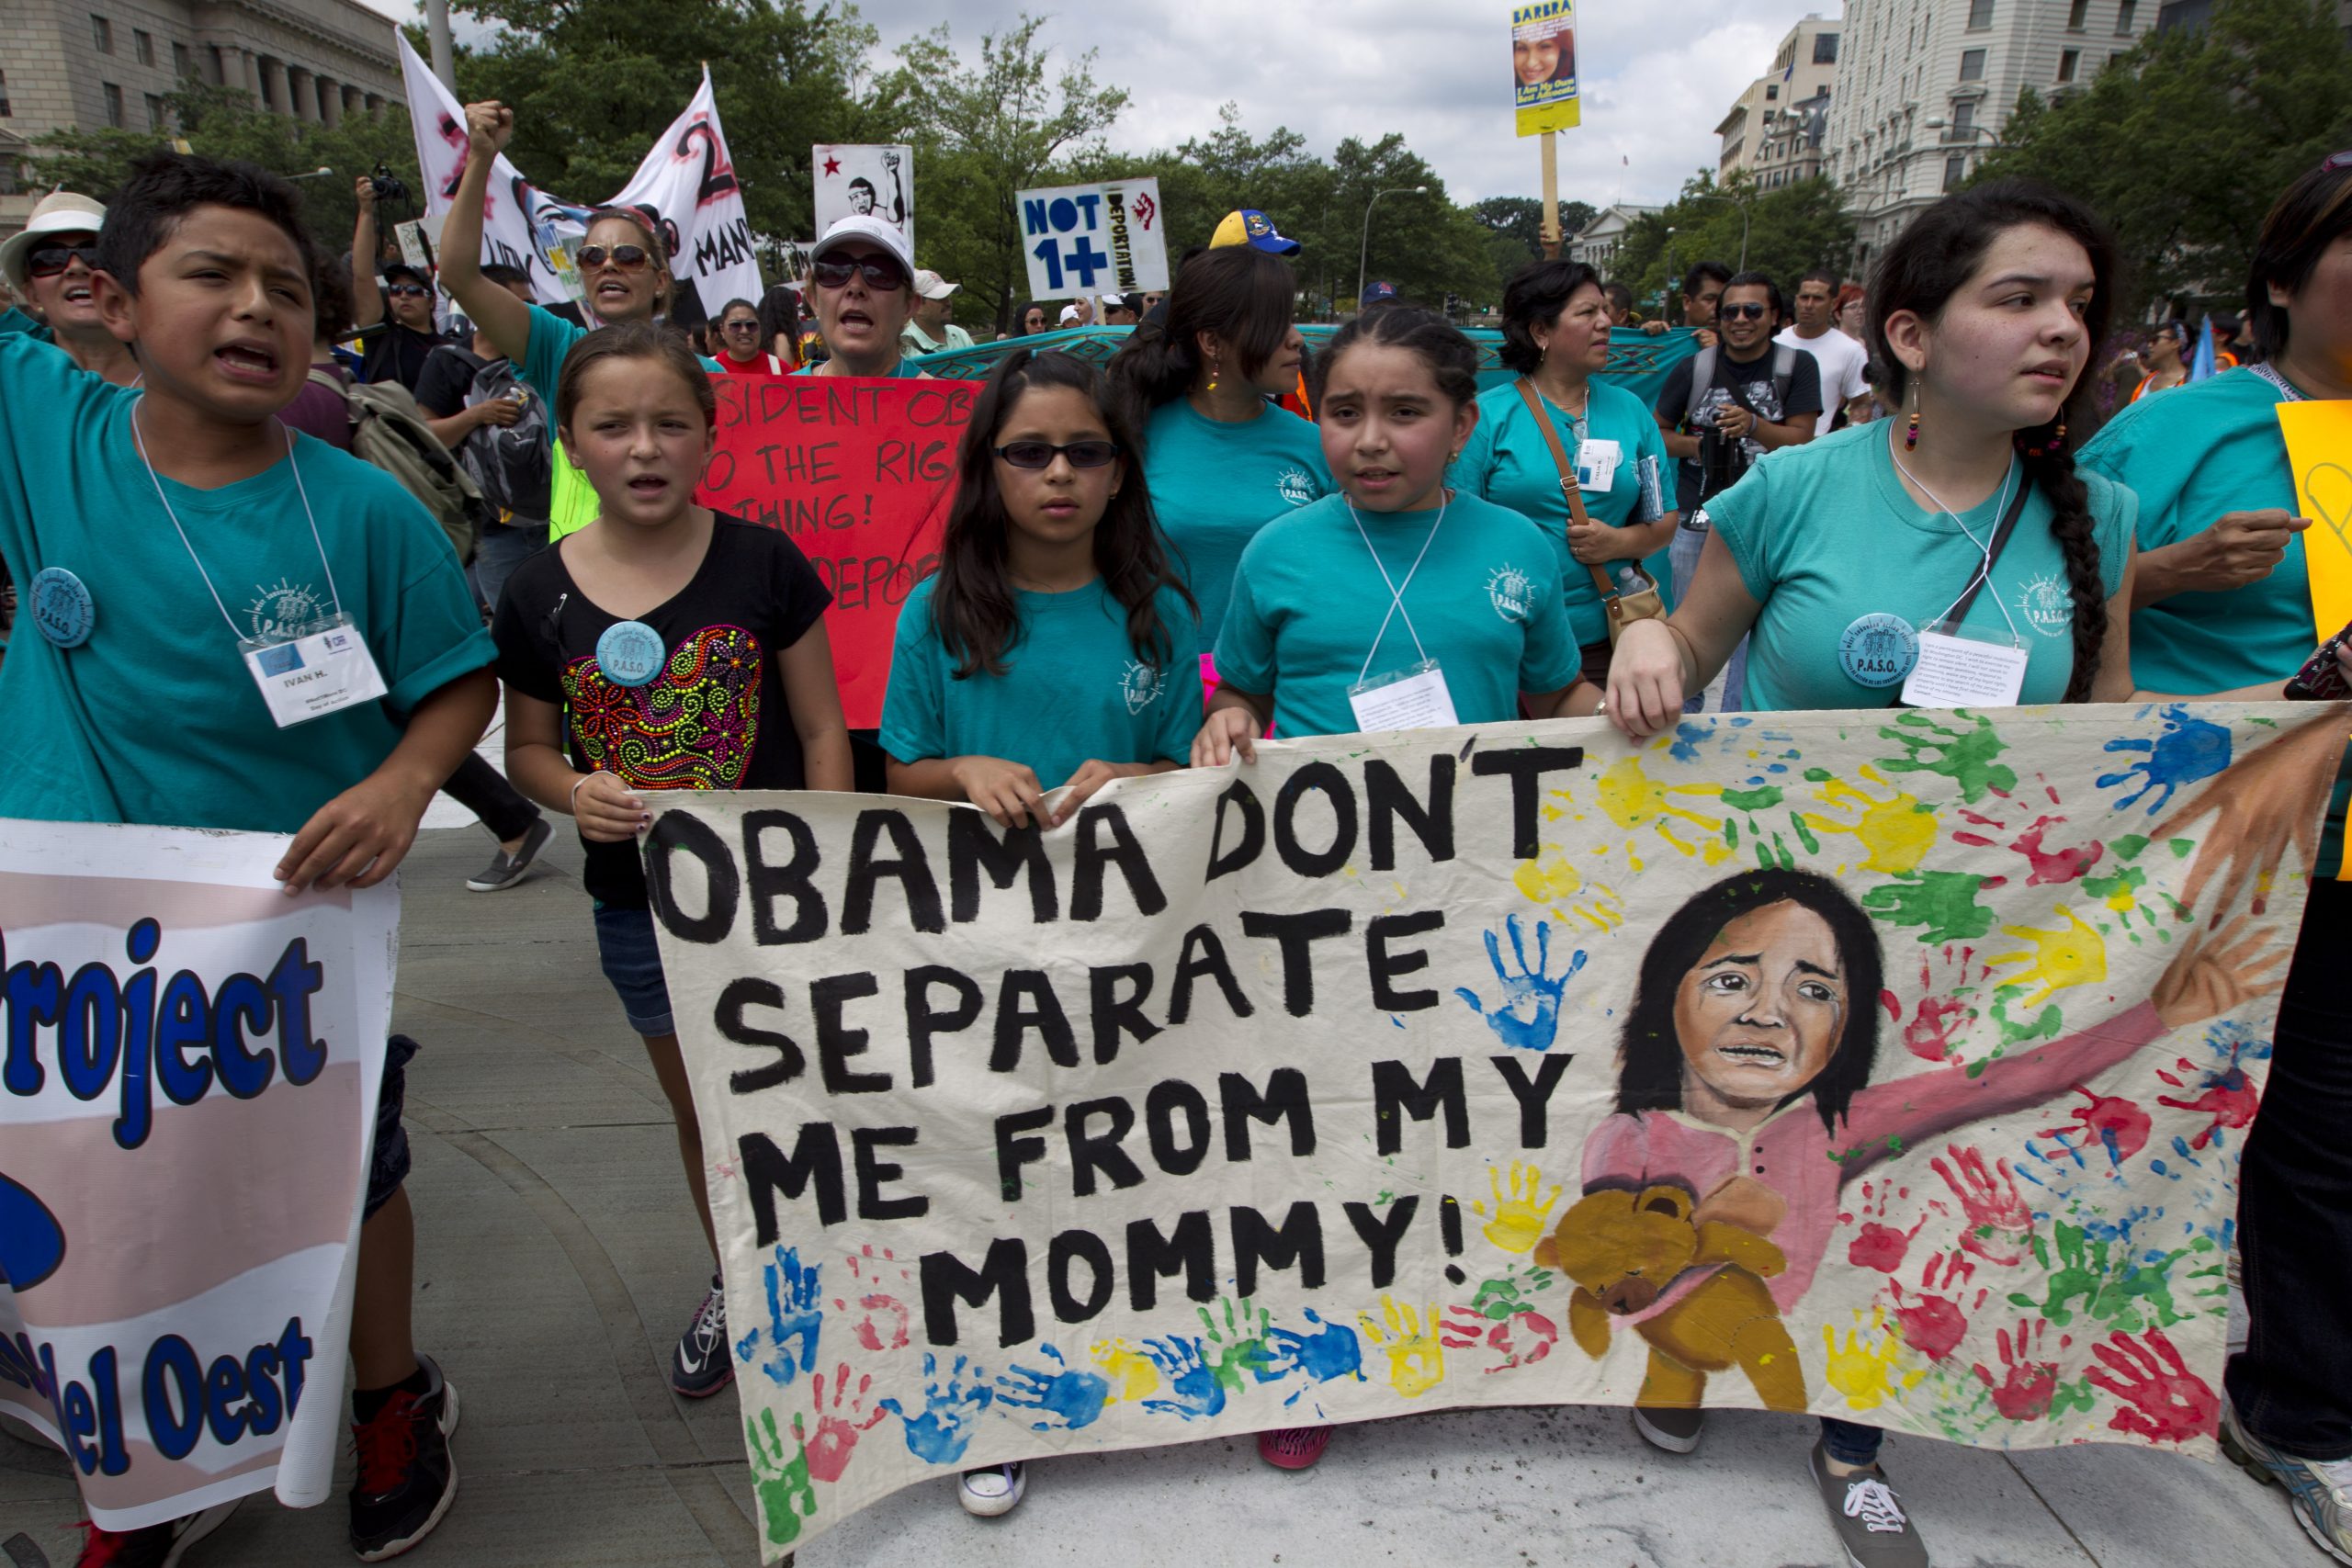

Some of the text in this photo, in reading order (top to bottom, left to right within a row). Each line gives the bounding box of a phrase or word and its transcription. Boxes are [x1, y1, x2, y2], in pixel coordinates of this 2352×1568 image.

[1513, 0, 1571, 23] BARBRA
[1023, 195, 1100, 235] NOT
[1106, 191, 1137, 287] DEPORTATION
[1034, 236, 1107, 289] 1+
[713, 378, 974, 428] SIDENT OB
[696, 440, 952, 492] O THE RIG
[731, 493, 874, 536] THING!
[284, 672, 313, 688] IVAN
[613, 660, 646, 673] P.A.S.O.
[1858, 659, 1897, 673] P.A.S.O.
[644, 734, 1584, 947] OBAMA DON'T
[714, 908, 1445, 1095] SEPARATE
[0, 917, 328, 1151] roject
[738, 1053, 1575, 1247] ME FROM MY
[919, 1194, 1466, 1349] MOMMY!
[141, 1316, 313, 1461] Oest
